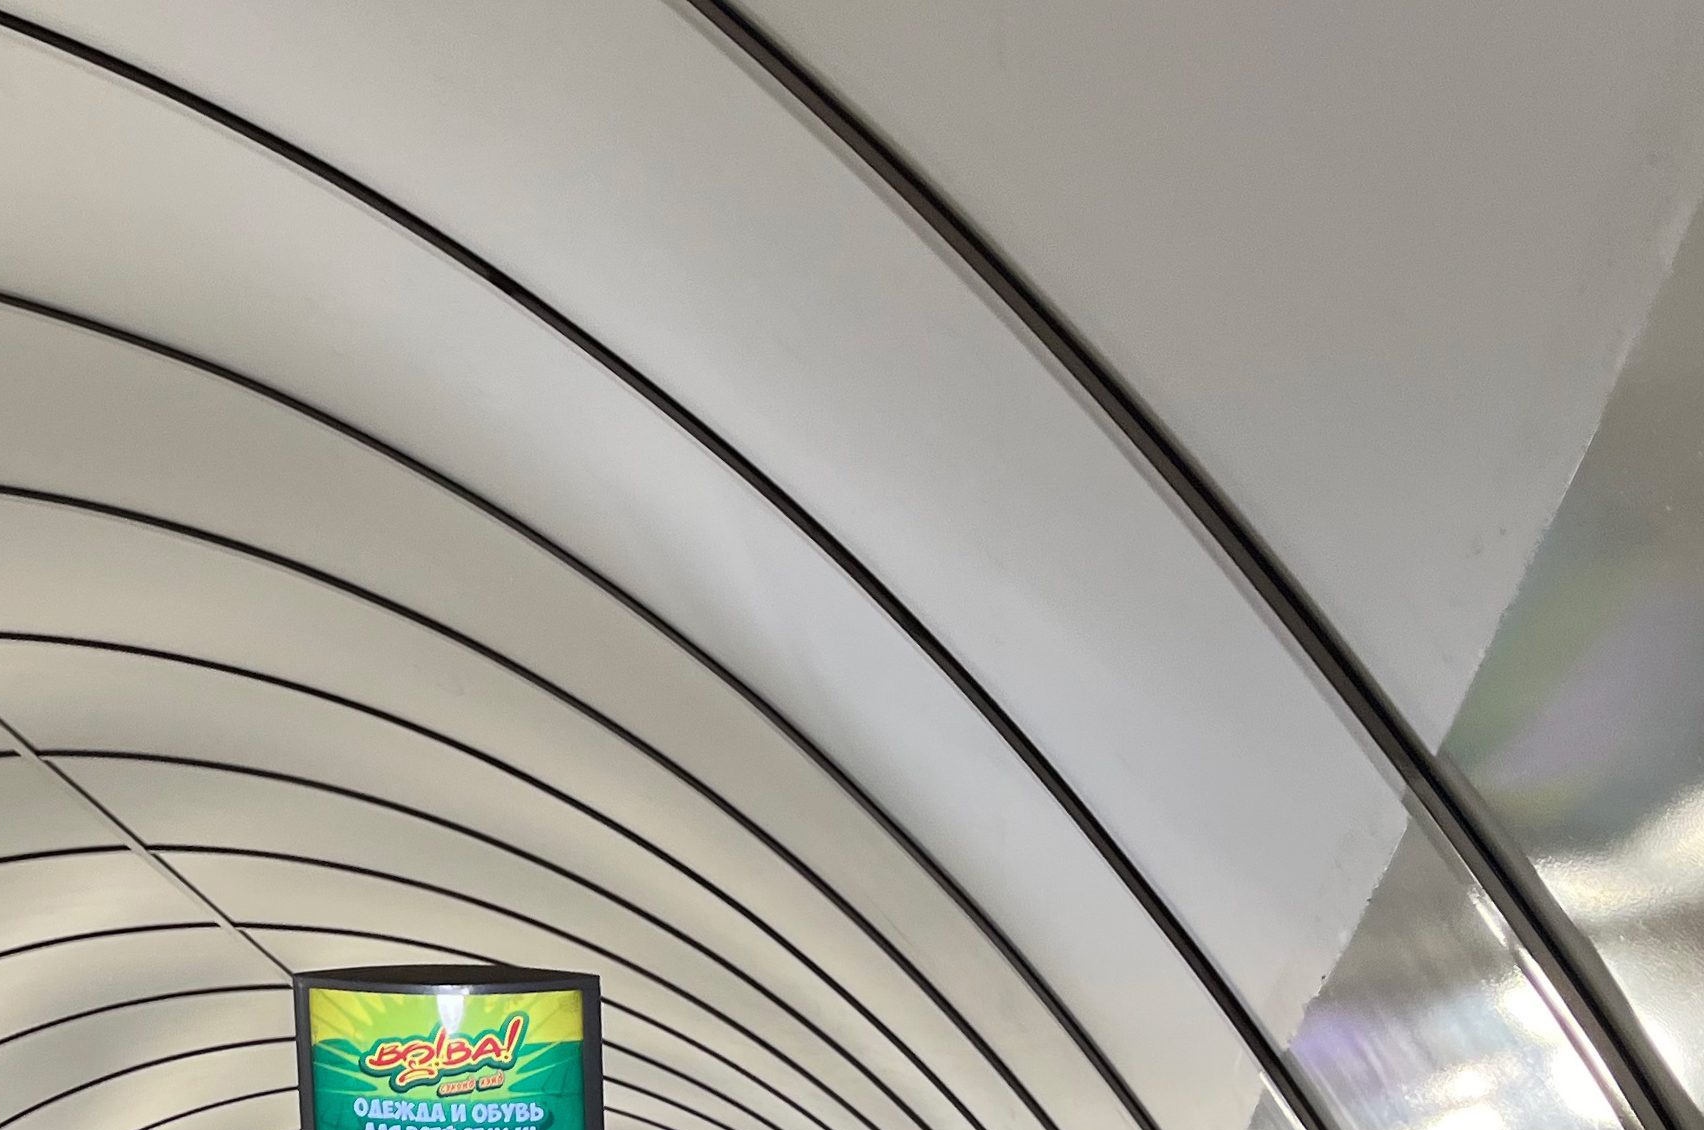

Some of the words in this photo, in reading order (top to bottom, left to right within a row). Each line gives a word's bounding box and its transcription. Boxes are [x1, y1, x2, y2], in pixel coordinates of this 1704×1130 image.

[354, 1098, 446, 1122] ОДЕЖДА
[451, 1103, 467, 1123] И
[472, 1102, 544, 1124] ОБУВЬ
